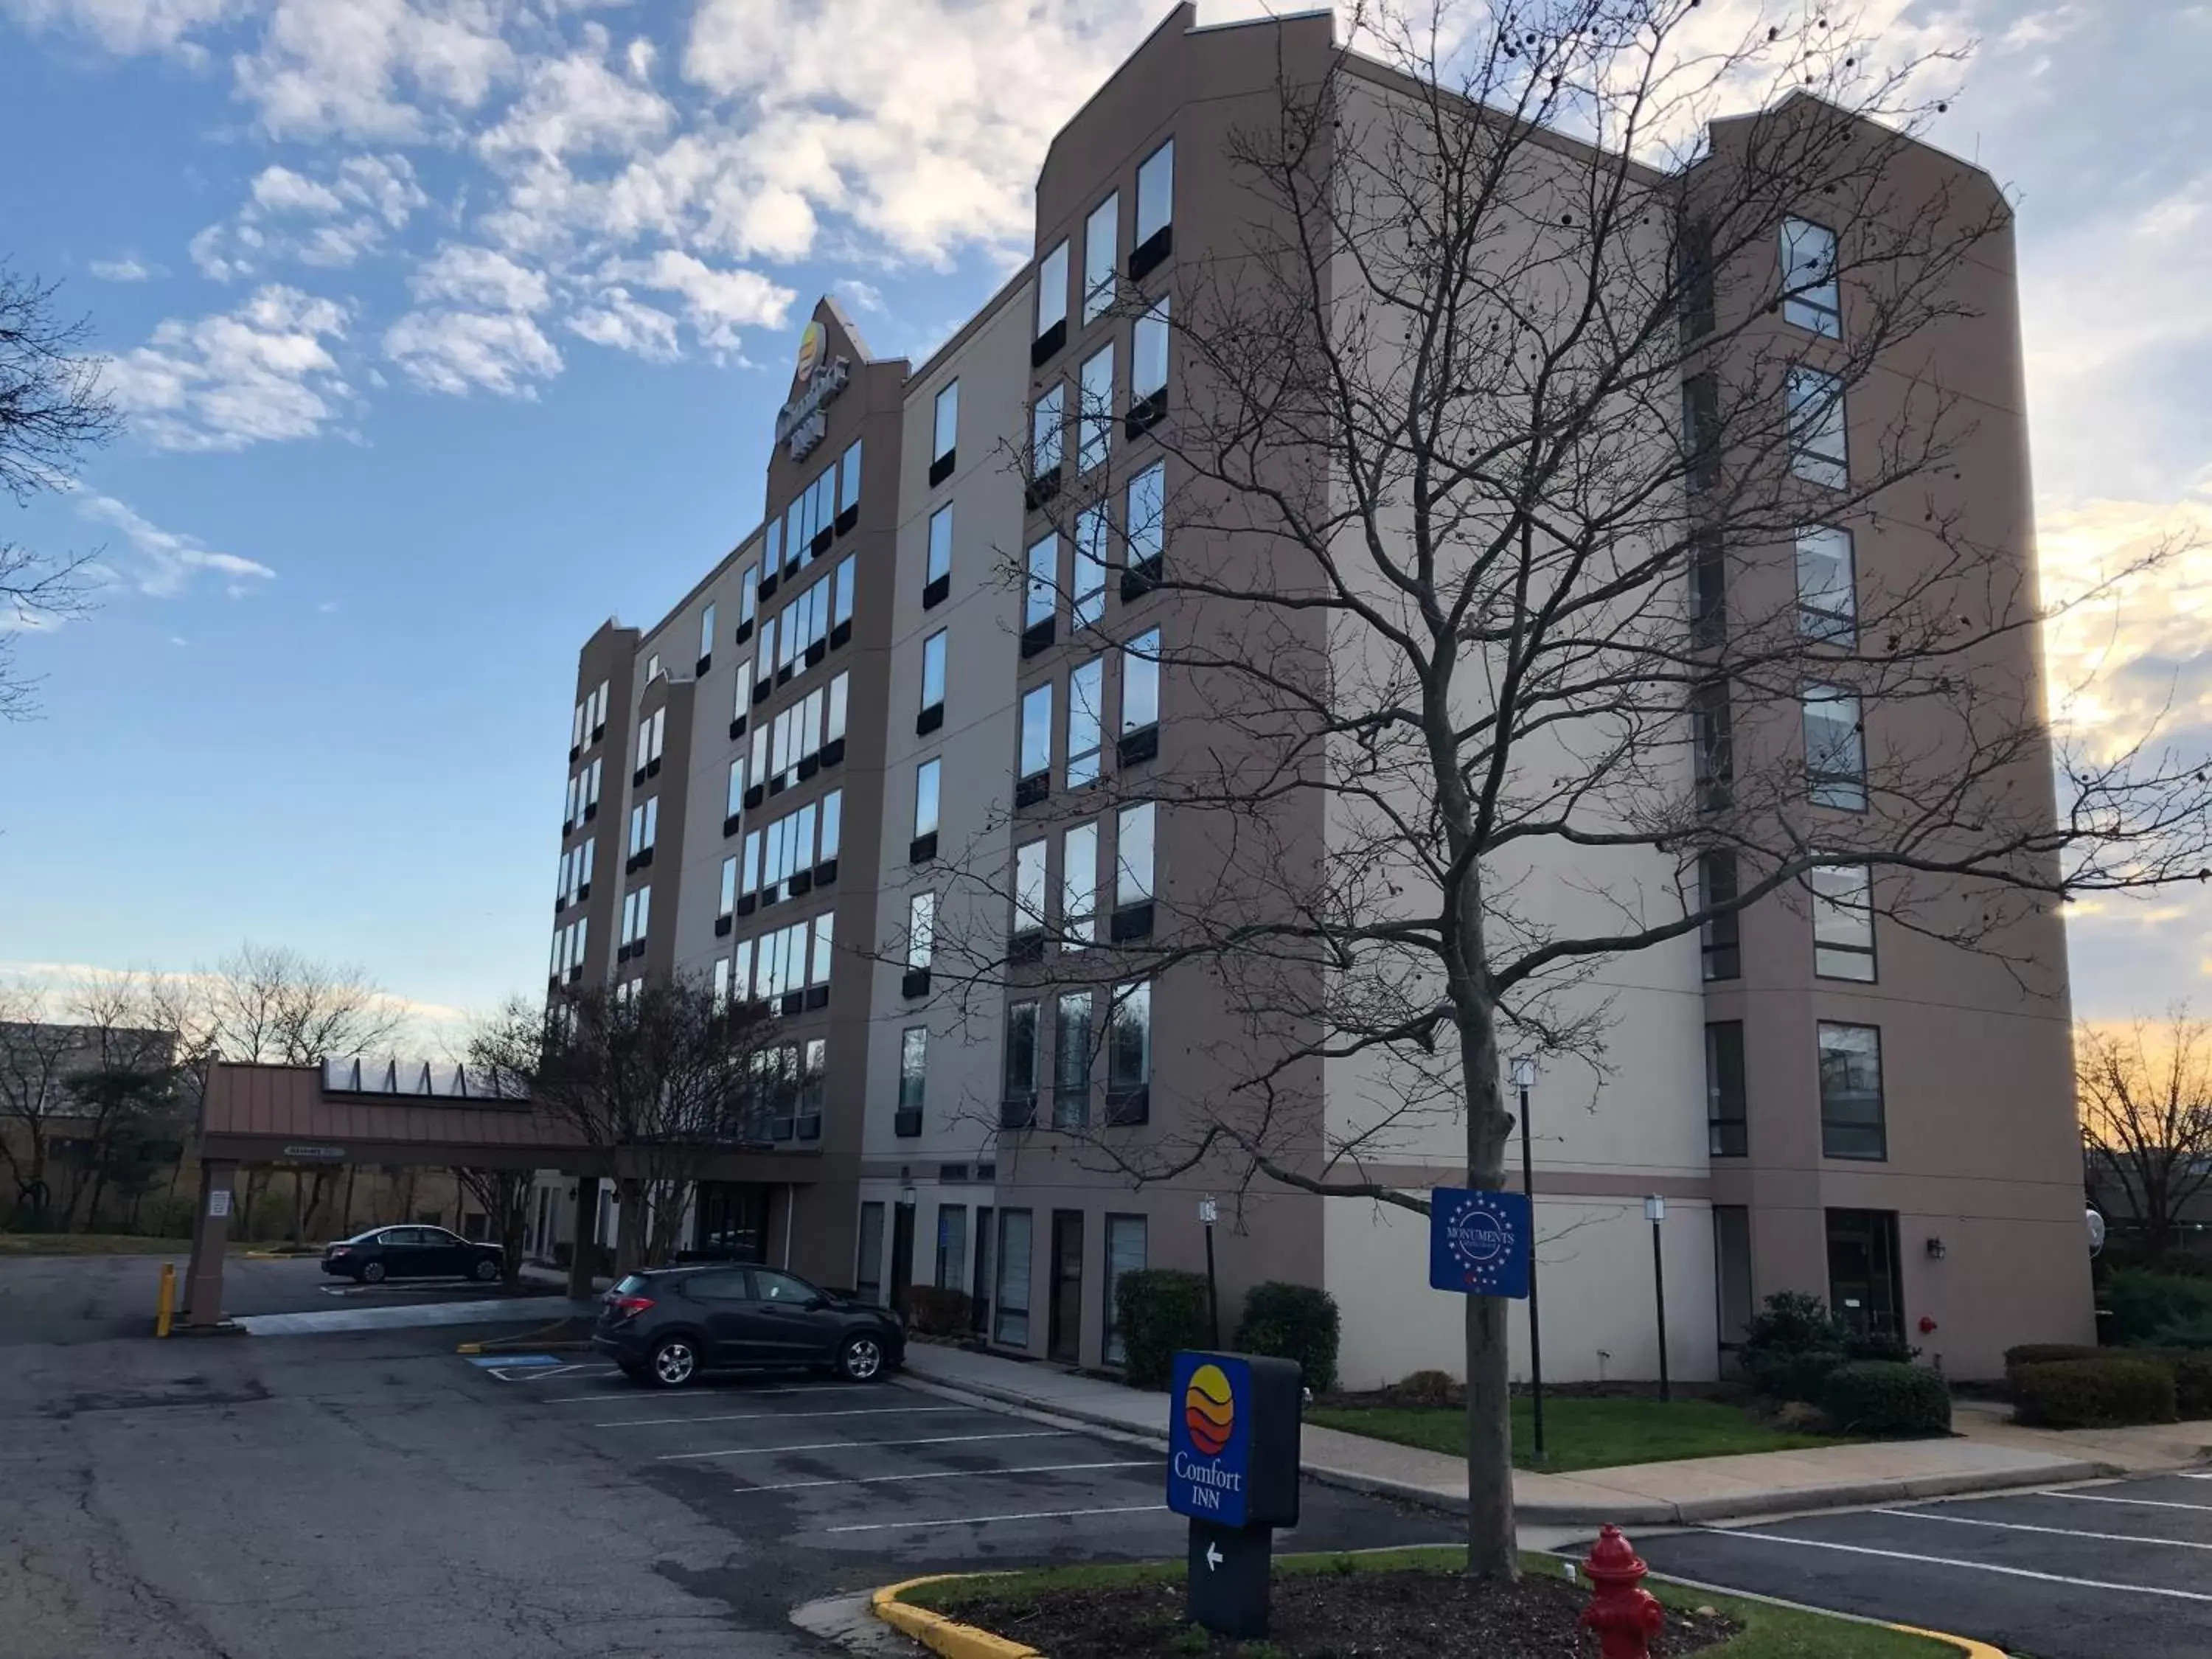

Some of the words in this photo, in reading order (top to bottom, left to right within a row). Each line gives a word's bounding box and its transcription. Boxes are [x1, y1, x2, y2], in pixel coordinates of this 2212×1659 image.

[1447, 1226, 1515, 1246] MONUMENTS
[1175, 1450, 1242, 1492] Comfort
[1192, 1485, 1220, 1510] INN
